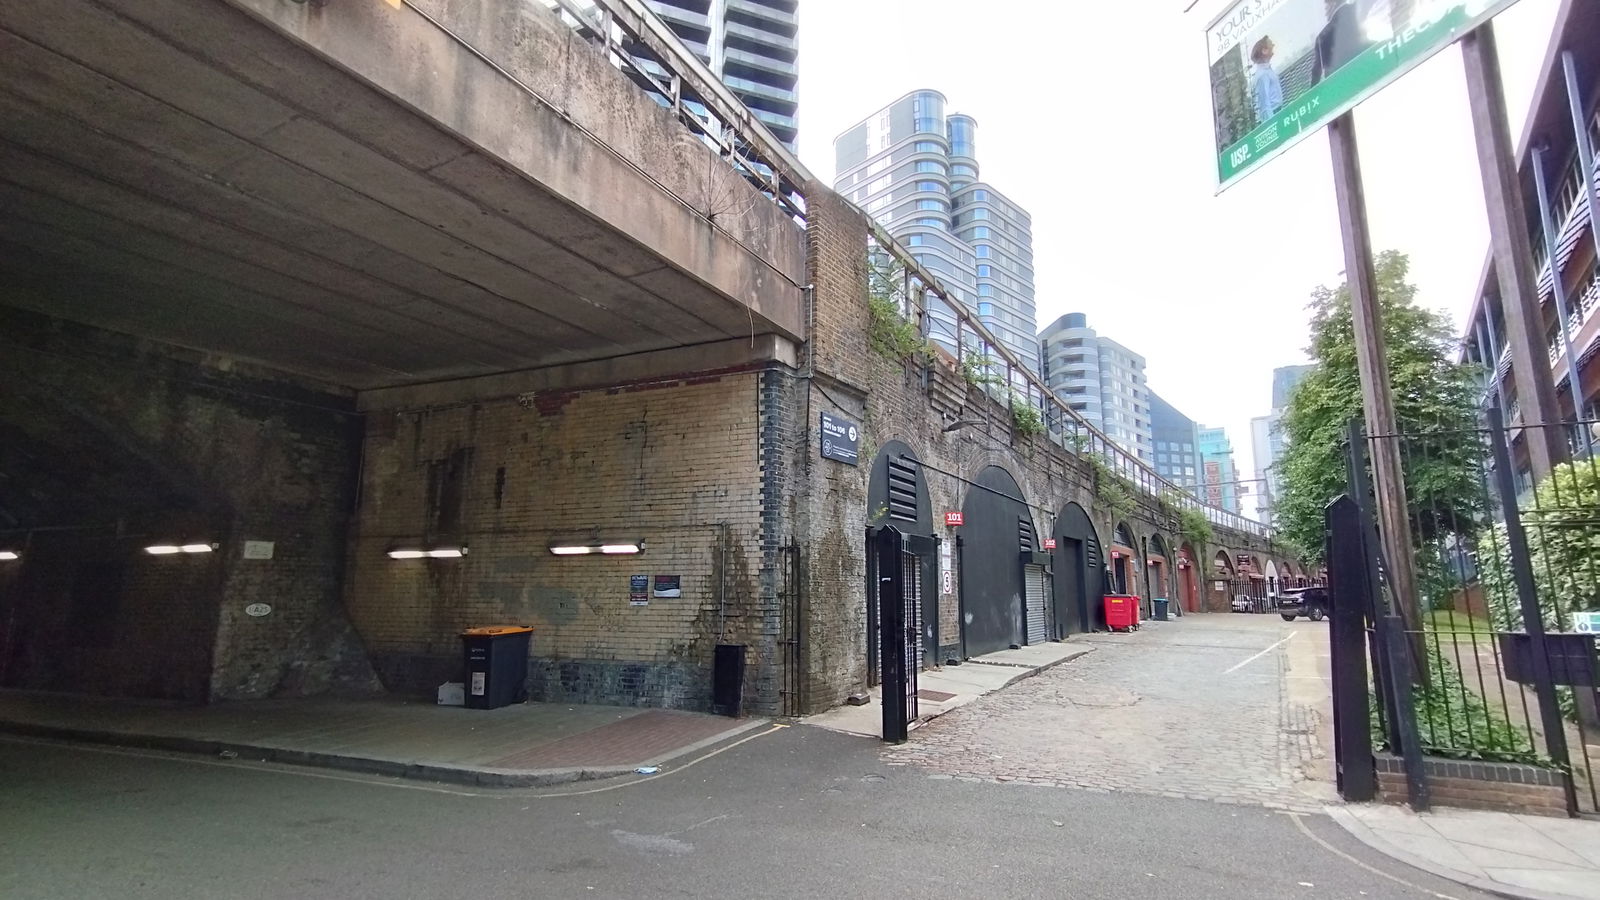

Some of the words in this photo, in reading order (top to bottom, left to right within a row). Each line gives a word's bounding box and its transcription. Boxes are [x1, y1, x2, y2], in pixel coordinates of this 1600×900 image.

[1216, 6, 1252, 41] YOUR
[1217, 38, 1231, 54] 98
[1283, 96, 1320, 127] RUBIX
[1255, 125, 1277, 144] AVISON
[1256, 132, 1278, 149] YOUNG
[946, 513, 962, 521] 101
